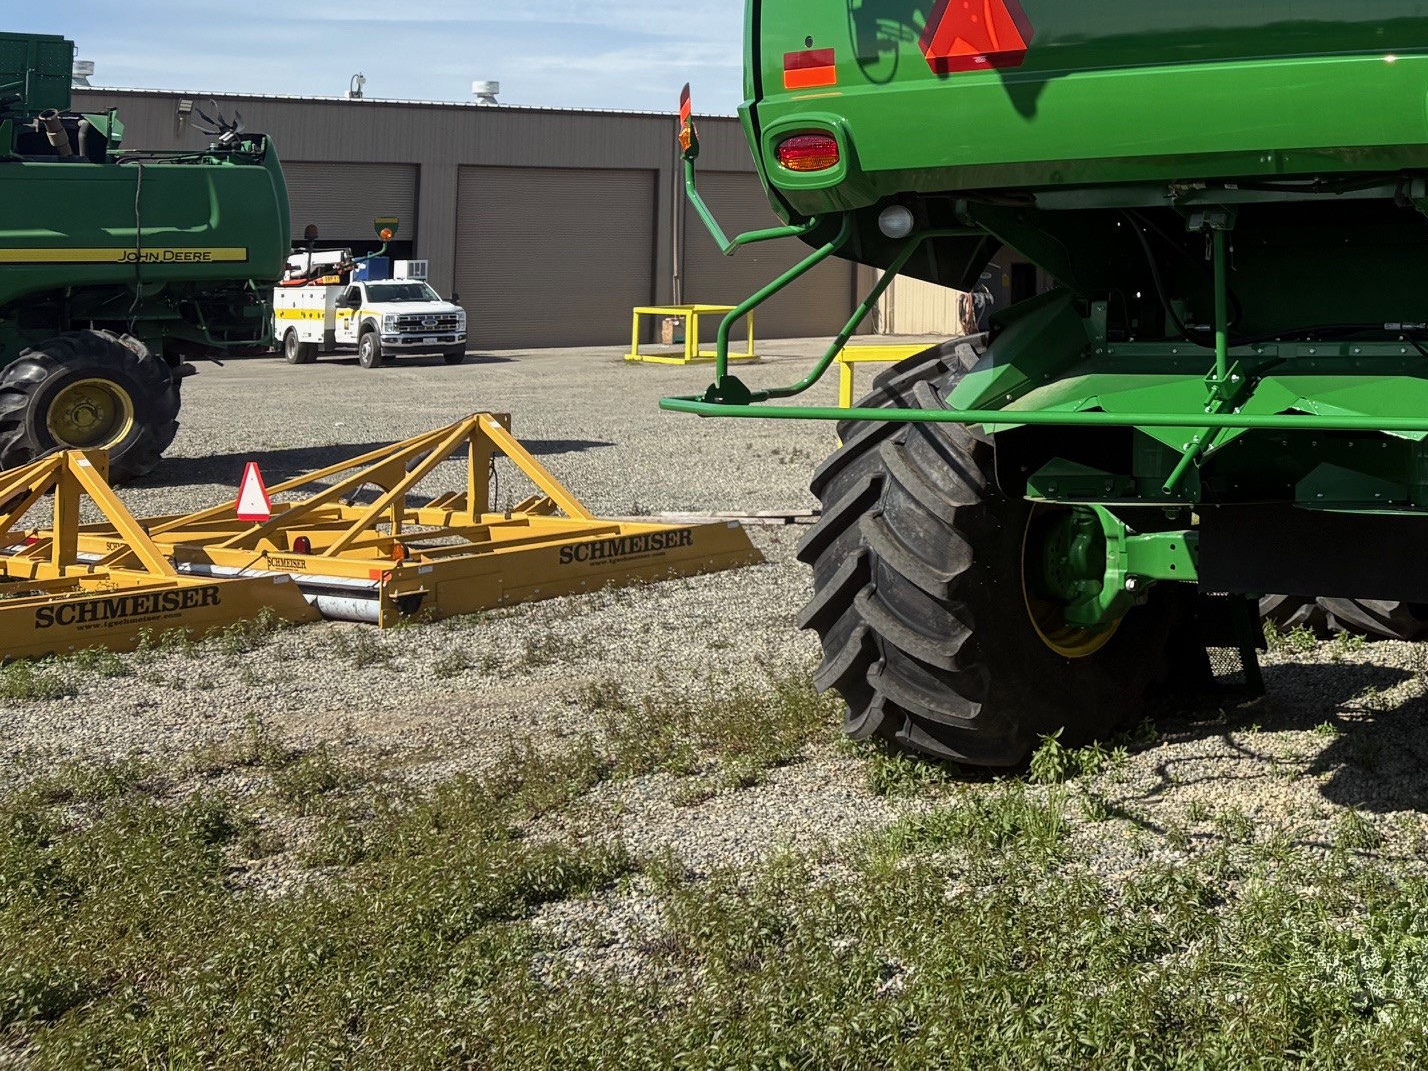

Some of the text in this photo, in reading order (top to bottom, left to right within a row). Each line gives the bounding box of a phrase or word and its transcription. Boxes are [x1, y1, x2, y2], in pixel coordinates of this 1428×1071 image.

[118, 250, 212, 262] JOHN DEERE
[559, 529, 694, 565] SCHMEISER
[267, 556, 307, 569] SCHMEISER
[34, 585, 221, 629] SCHMEISER
[76, 612, 182, 631] www.tgschmeiser.com
